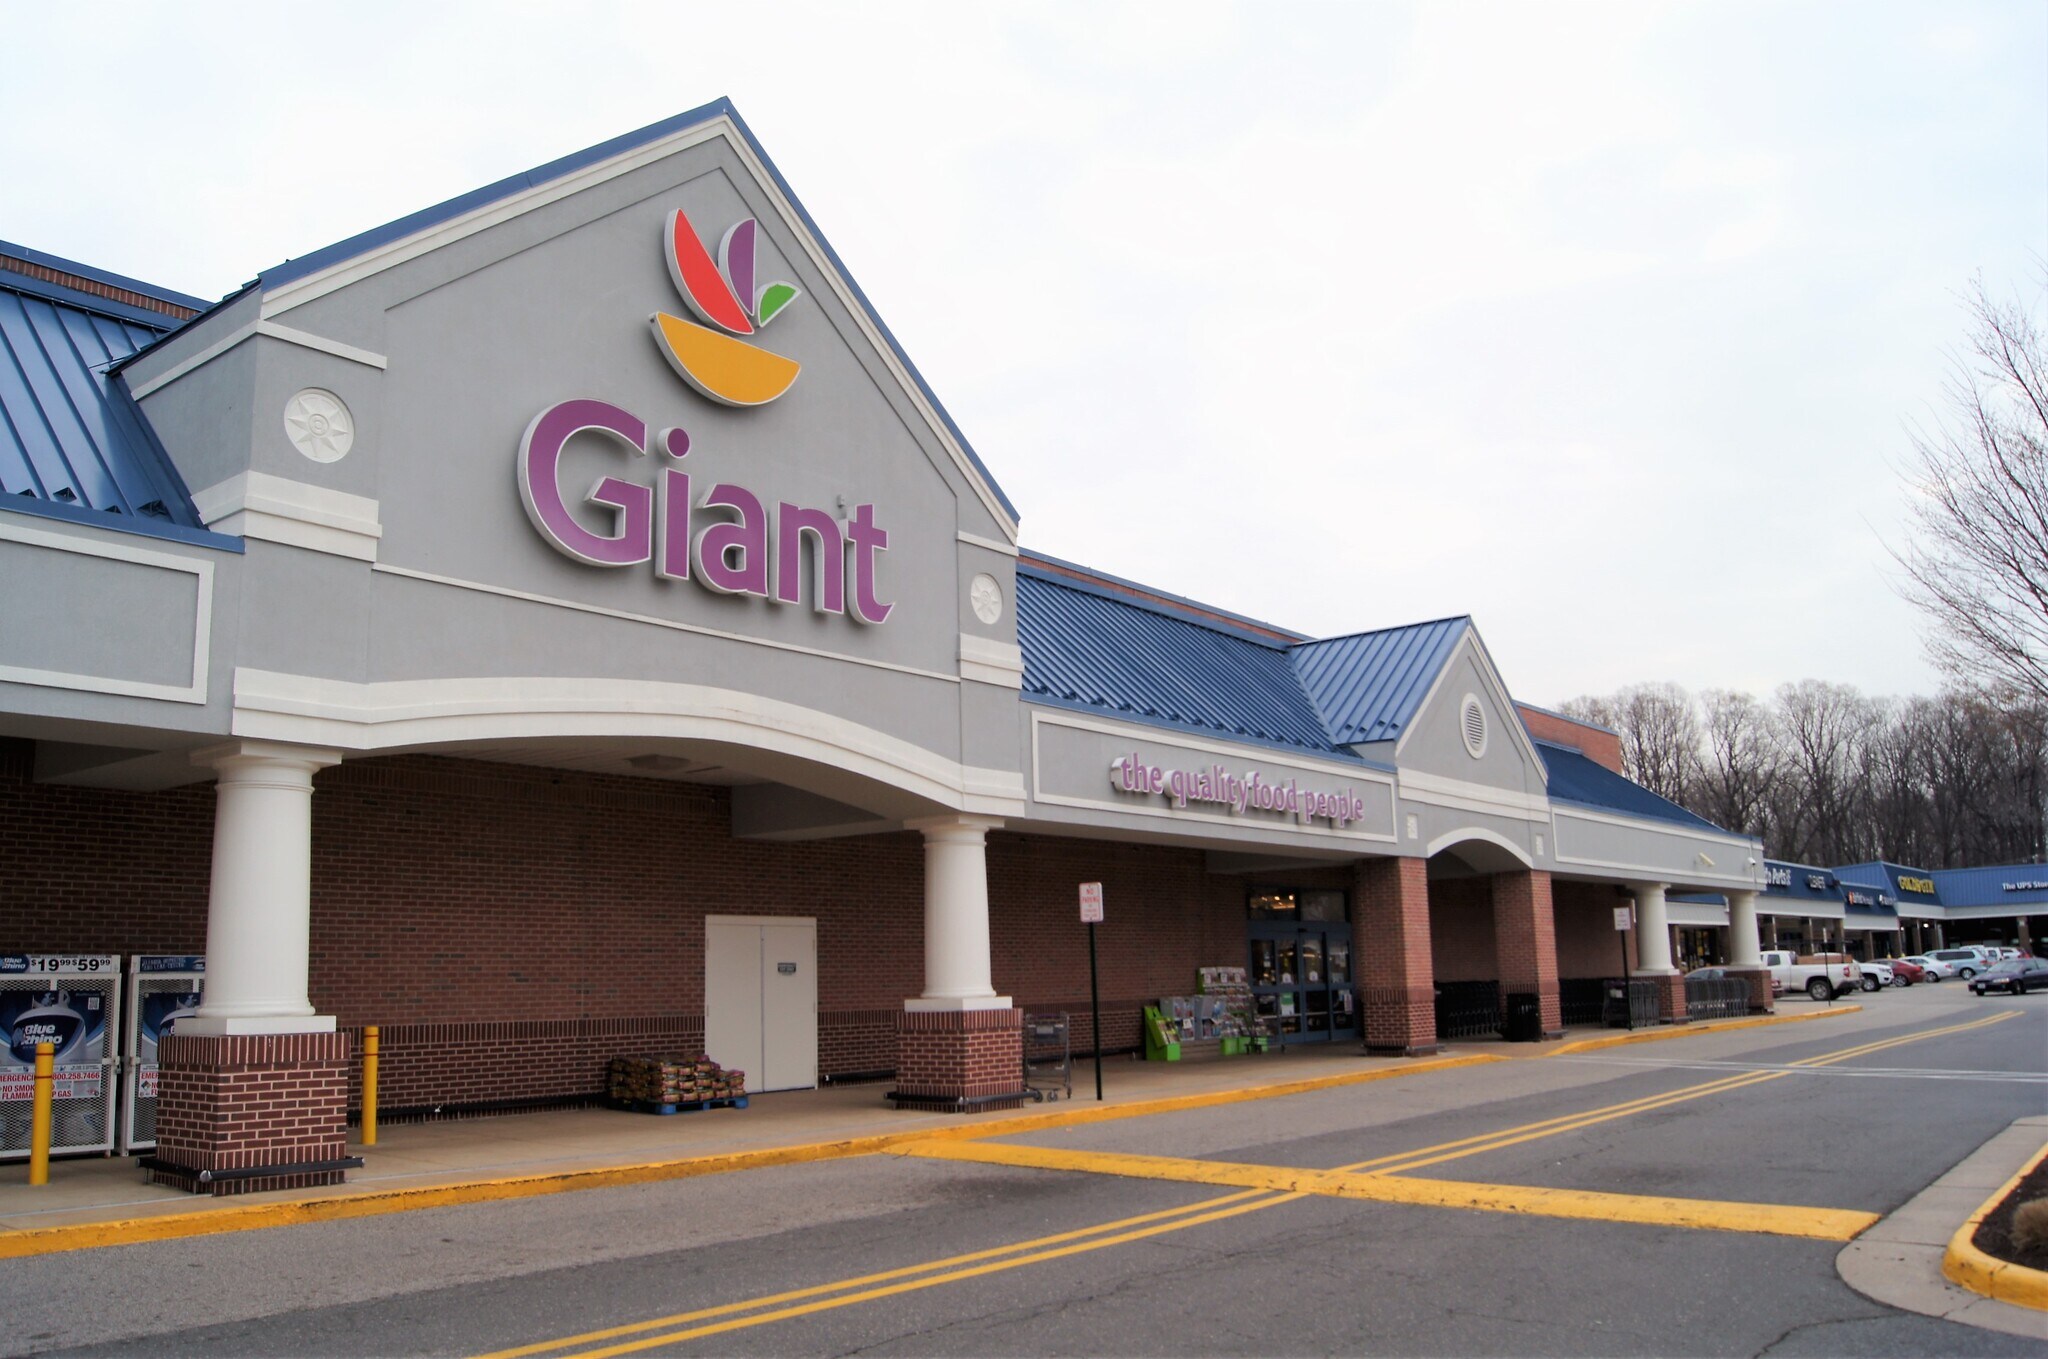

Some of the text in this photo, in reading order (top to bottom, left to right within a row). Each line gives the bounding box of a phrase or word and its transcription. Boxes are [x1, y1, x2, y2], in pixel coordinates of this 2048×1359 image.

[518, 398, 895, 625] Giant
[1120, 752, 1365, 827] the quality food people
[2002, 882, 2016, 890] The
[2016, 881, 2032, 889] UPS
[24, 1024, 55, 1035] Blue
[21, 1034, 63, 1045] Rhino
